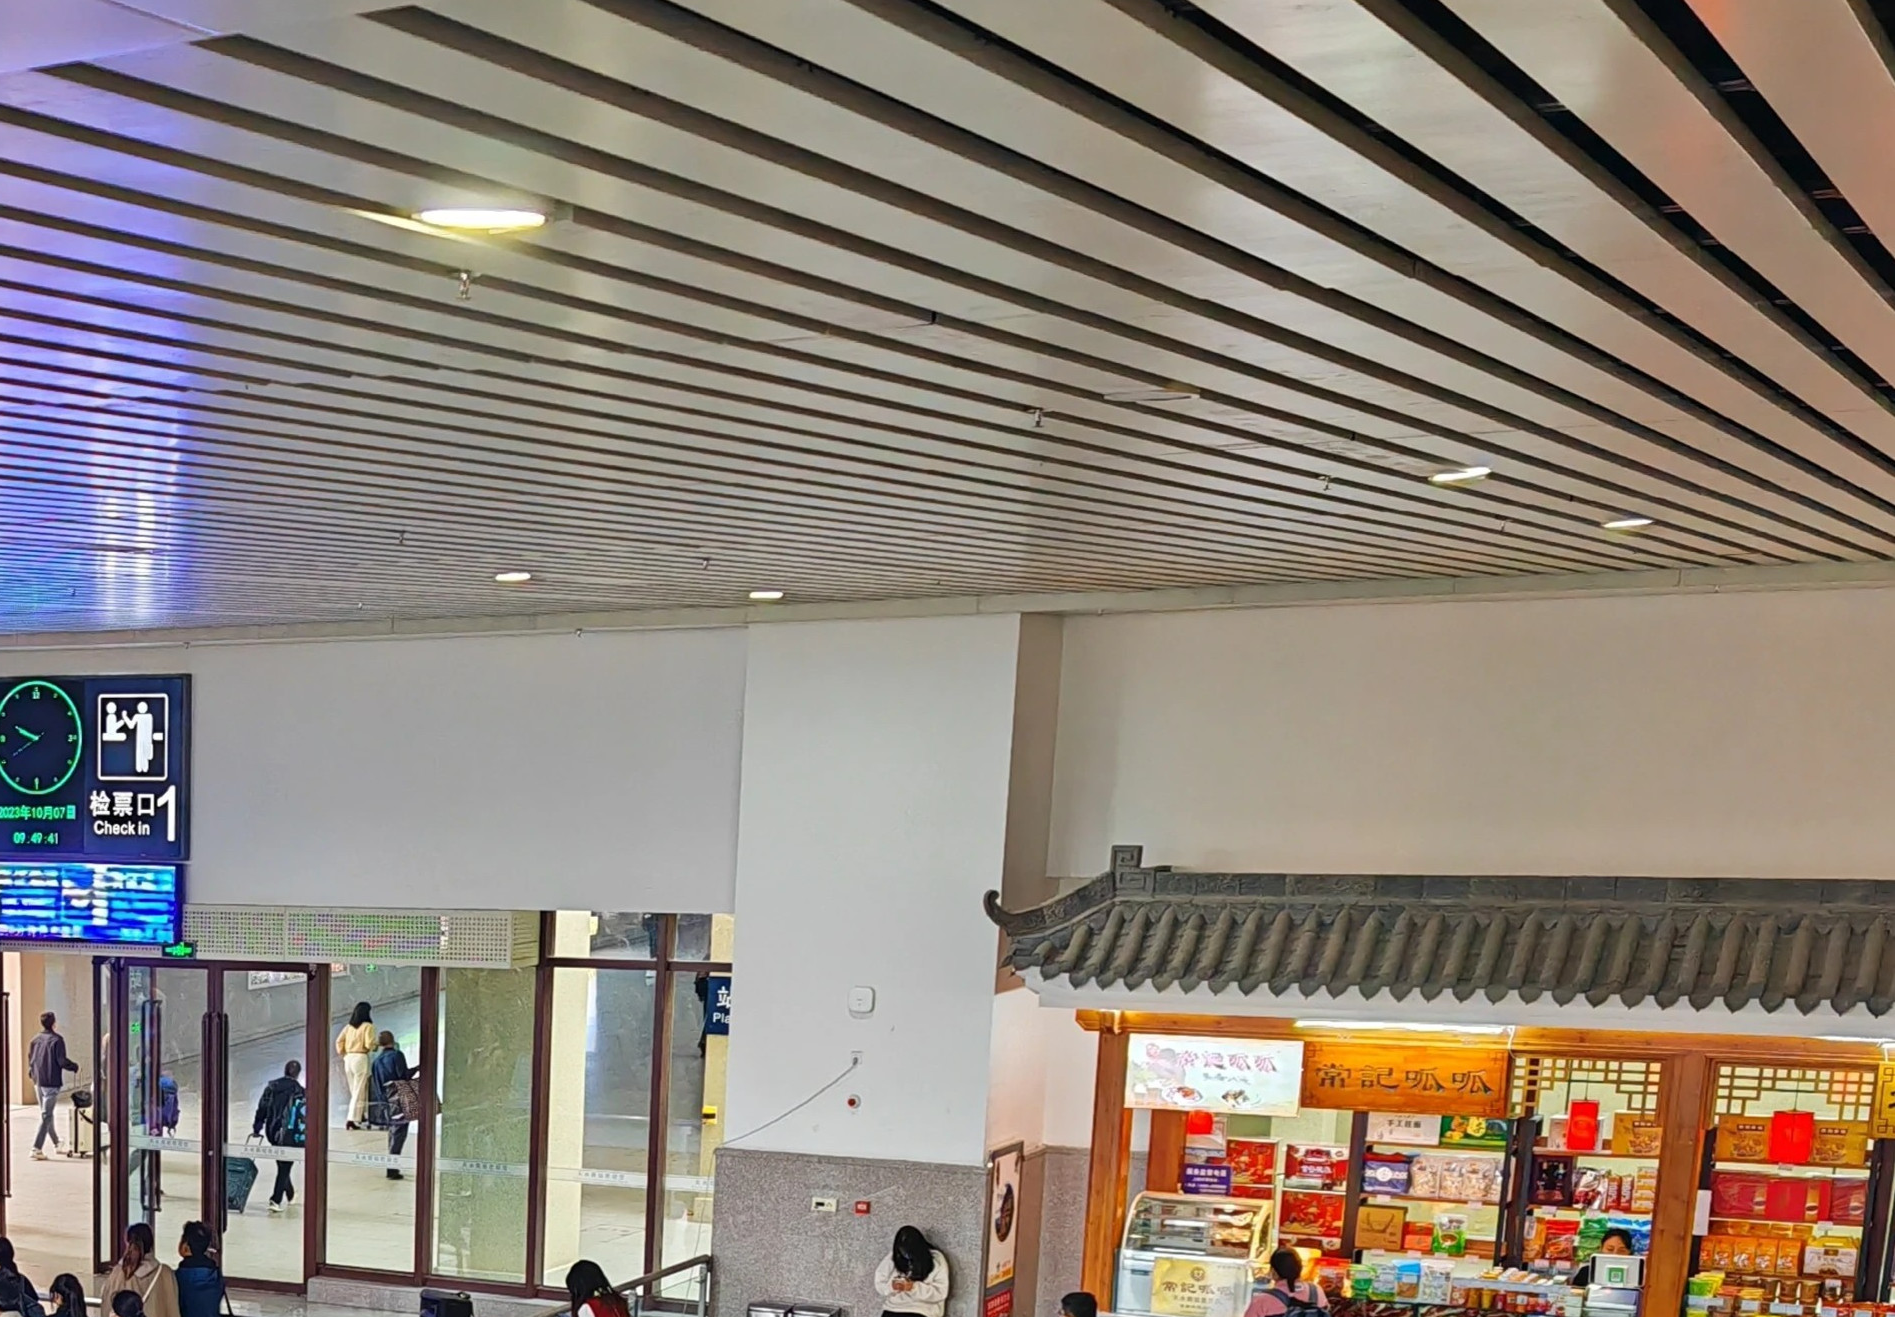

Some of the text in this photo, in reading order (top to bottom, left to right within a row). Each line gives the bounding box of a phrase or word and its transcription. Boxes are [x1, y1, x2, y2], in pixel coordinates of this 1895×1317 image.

[90, 790, 155, 817] 检票口
[157, 785, 176, 842] 1
[13, 832, 58, 845] 09:49:41
[93, 820, 150, 836] Check in
